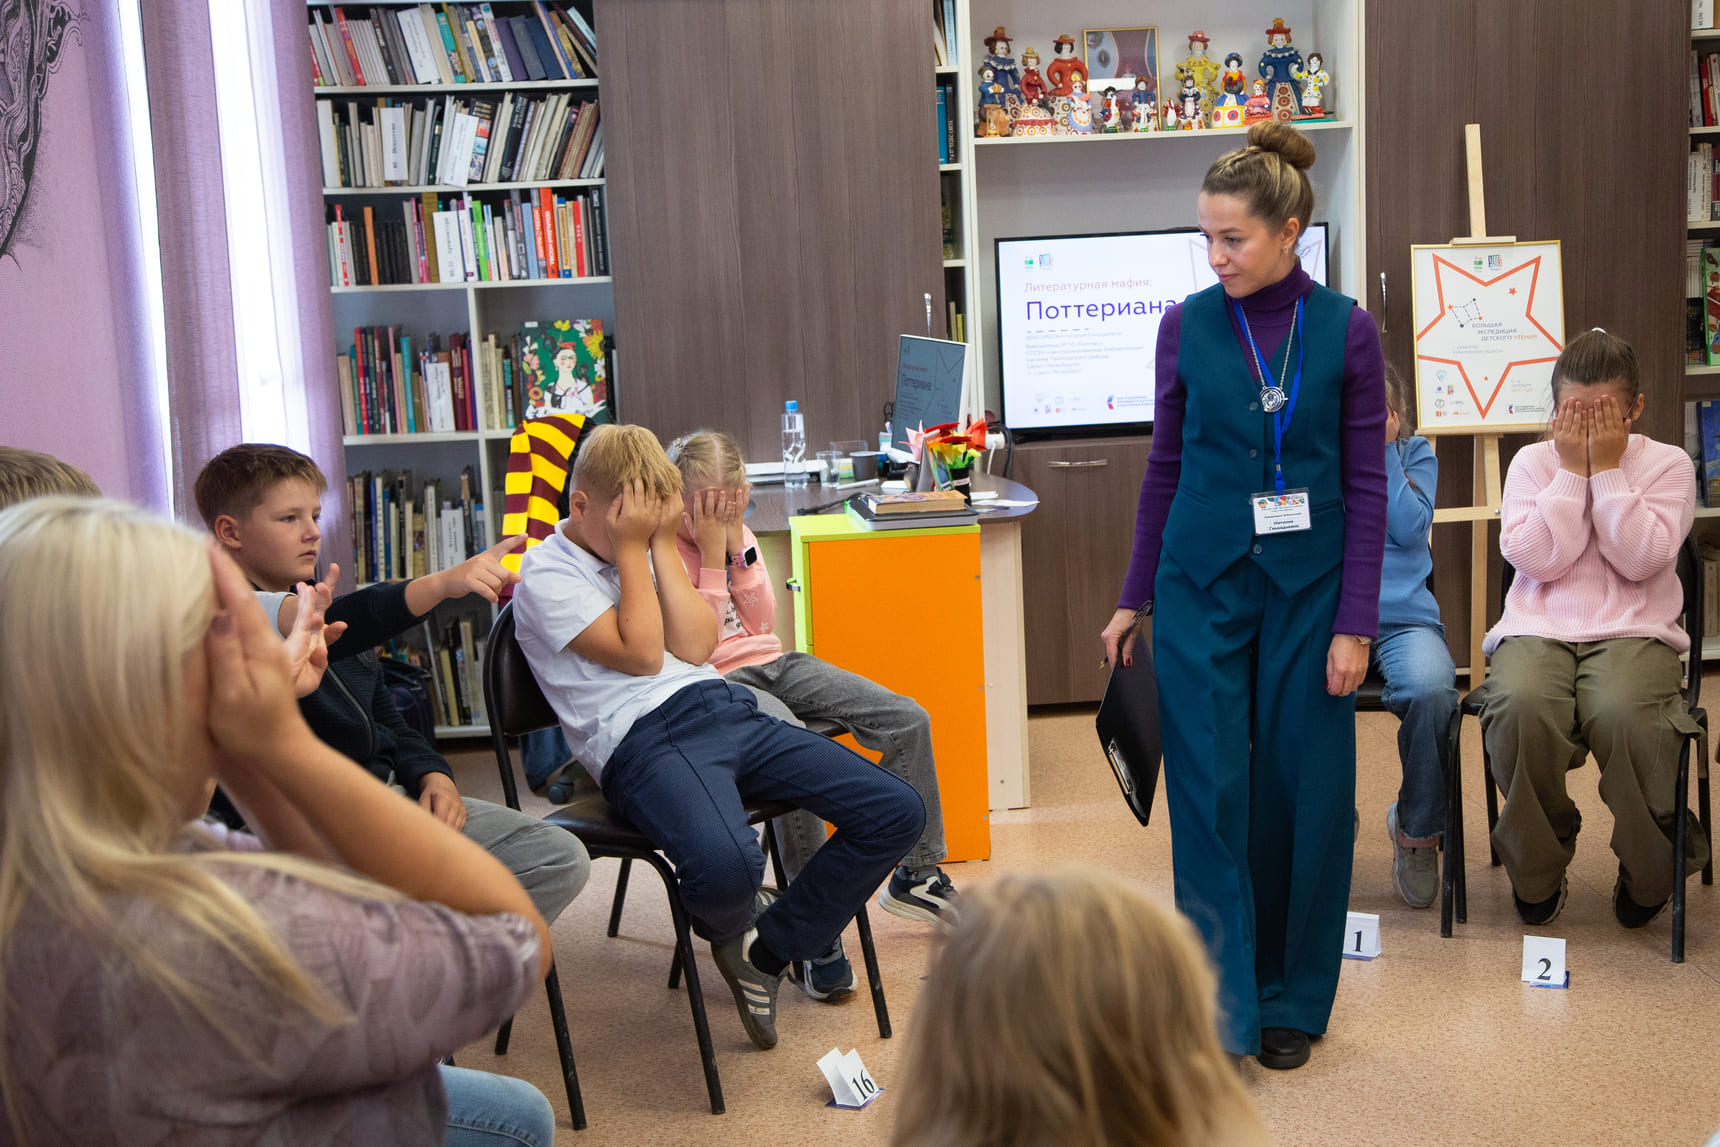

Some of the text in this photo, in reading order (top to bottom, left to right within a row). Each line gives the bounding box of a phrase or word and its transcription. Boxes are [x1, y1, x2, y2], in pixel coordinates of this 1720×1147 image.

[1024, 278, 1152, 293] Литературная мафия:
[1026, 299, 1177, 322] Поттериана
[1353, 930, 1363, 953] 1
[1537, 957, 1552, 981] 2
[852, 1069, 875, 1101] 16
